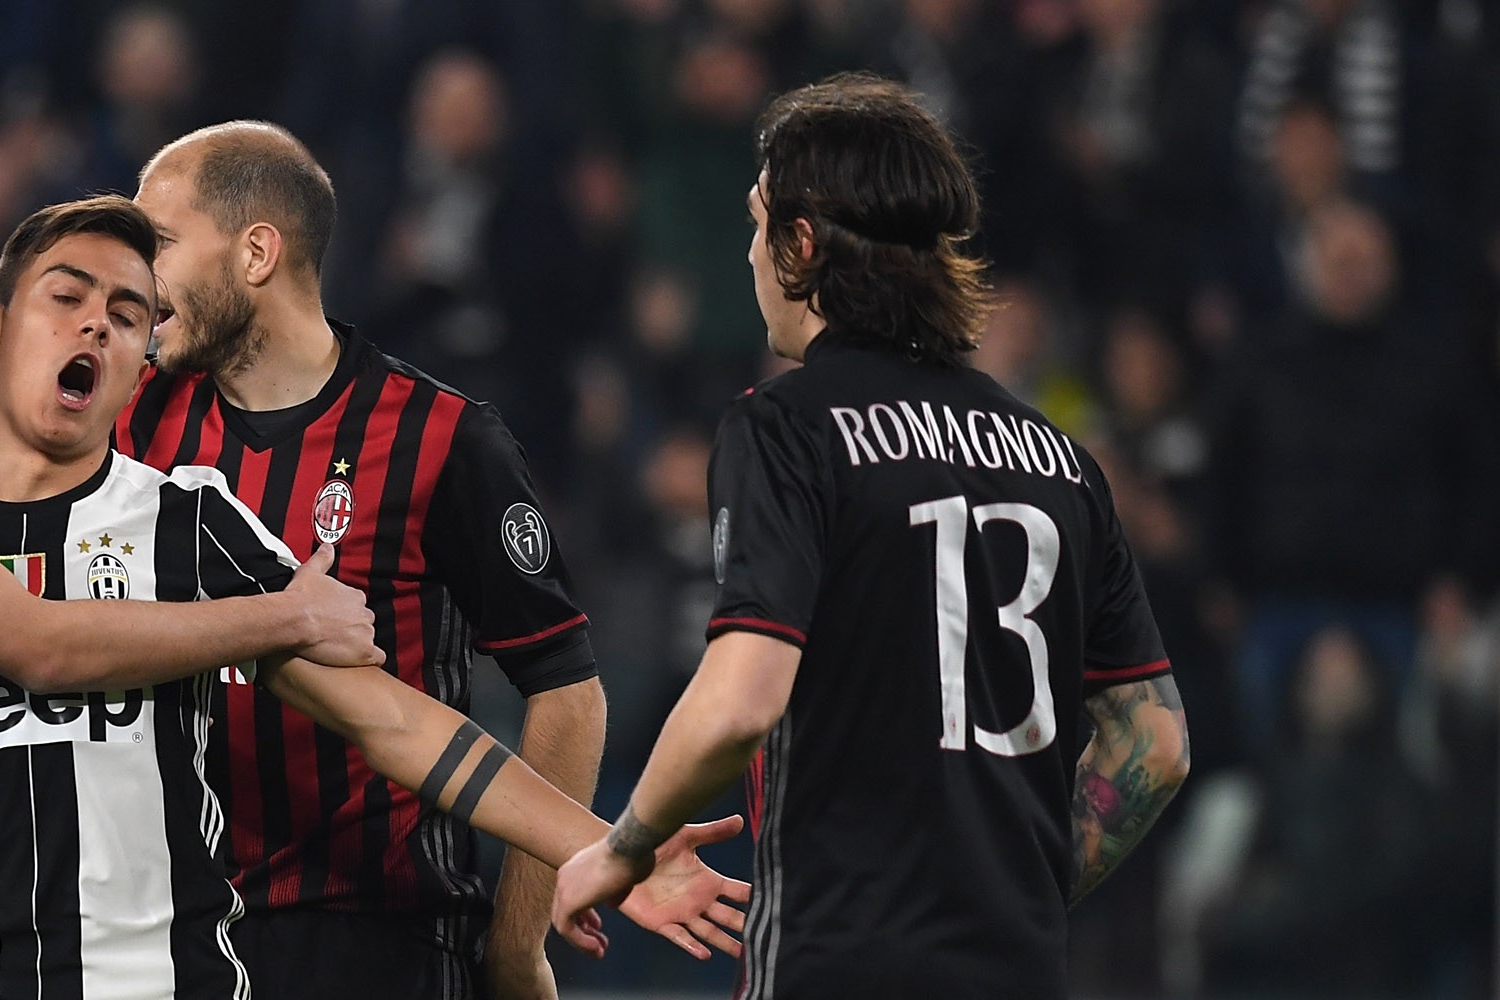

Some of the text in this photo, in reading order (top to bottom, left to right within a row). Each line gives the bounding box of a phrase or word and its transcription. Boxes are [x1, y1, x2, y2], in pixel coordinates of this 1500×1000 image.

[324, 483, 348, 498] ACM
[320, 530, 340, 540] 1899
[91, 567, 124, 577] JUVENTUS
[908, 494, 1061, 758] 13
